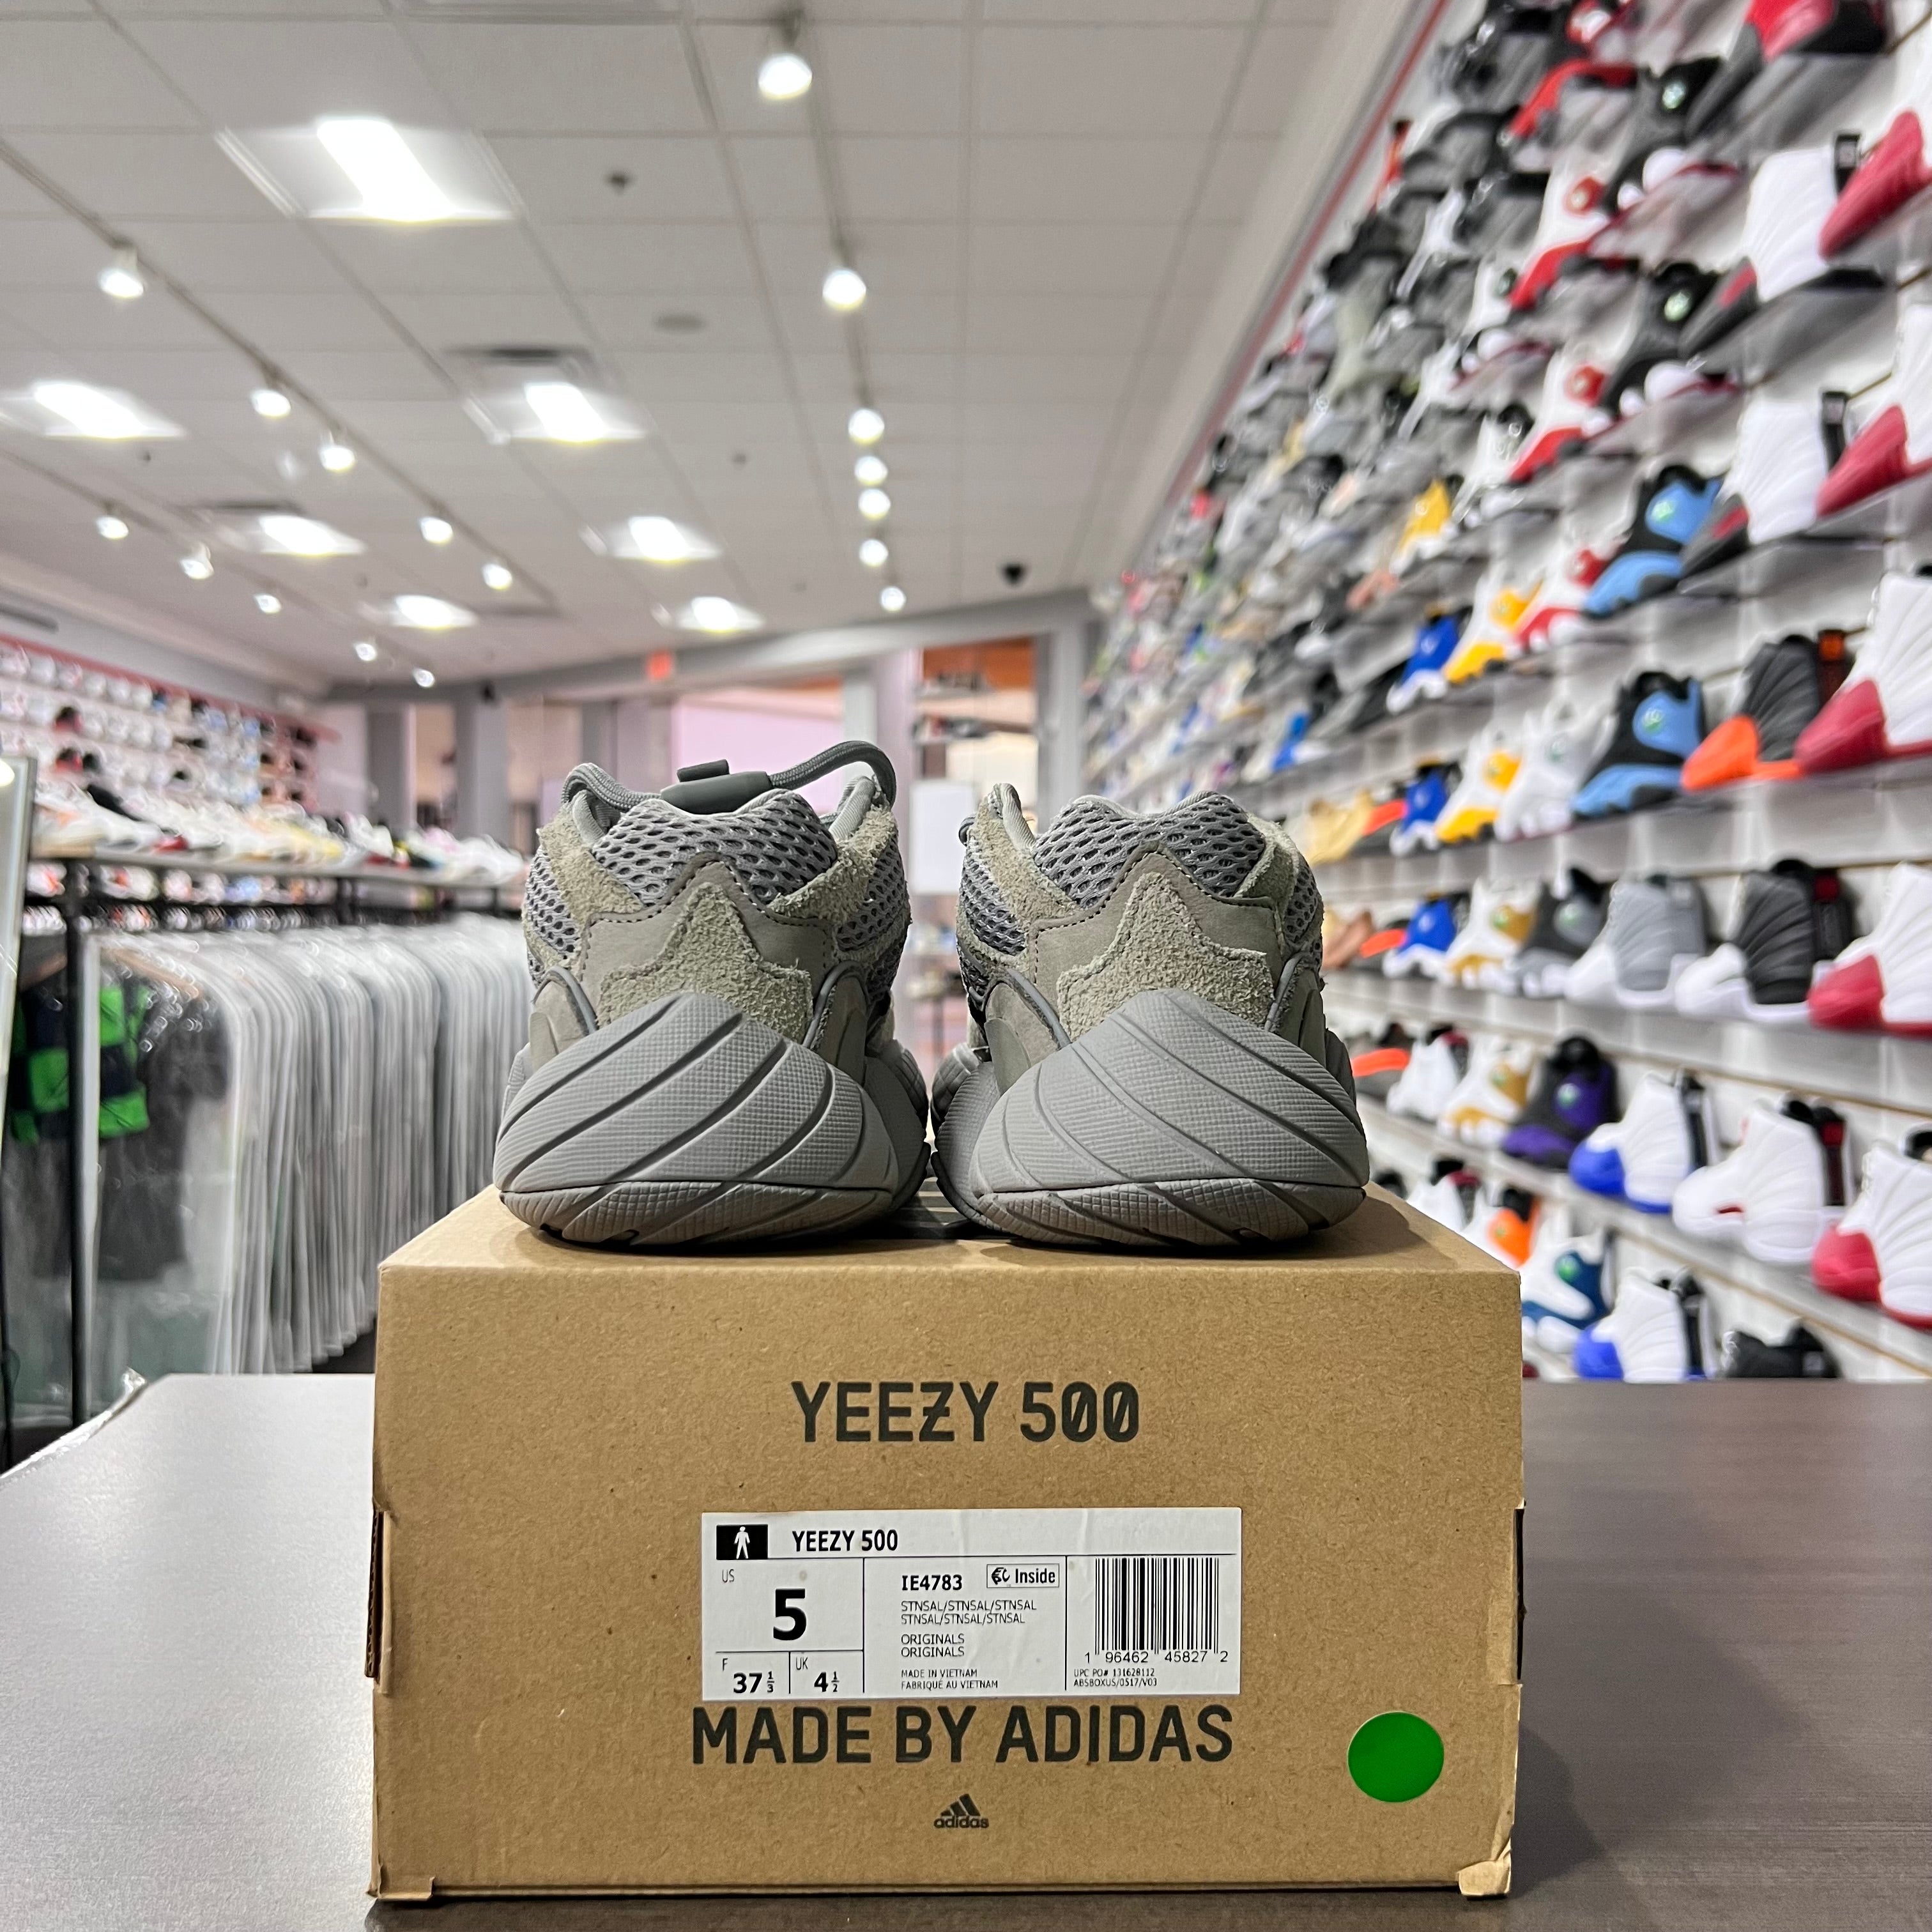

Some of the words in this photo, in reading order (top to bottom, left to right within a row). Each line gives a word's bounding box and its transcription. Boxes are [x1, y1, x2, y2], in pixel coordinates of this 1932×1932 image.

[791, 1381, 999, 1442] YEEZY
[1020, 1381, 1139, 1442] 500
[792, 1530, 855, 1552] YEEZY
[861, 1529, 898, 1551] 500
[721, 1568, 735, 1583] US
[1015, 1568, 1055, 1584] Inside
[901, 1574, 962, 1591] IE4783
[901, 1600, 1037, 1613] STNSAL/STNSAL/STNSAL
[773, 1588, 807, 1641] 5
[901, 1613, 1025, 1625] STNSAL/STNSAL/STNSAL
[901, 1633, 965, 1644] ORIGINALS
[901, 1646, 965, 1657] ORIGINALS
[1084, 1652, 1090, 1664] 1
[1105, 1652, 1149, 1663] 96462
[1164, 1650, 1208, 1662] 45827
[1220, 1650, 1229, 1662] 2
[722, 1658, 728, 1671] F
[795, 1657, 808, 1671] UK
[901, 1669, 925, 1678] MADE
[928, 1669, 937, 1678] IN
[939, 1669, 977, 1678] VIETNAM
[1073, 1668, 1089, 1677] UPC
[1092, 1668, 1108, 1677] PO#
[1112, 1668, 1155, 1677] 131628112
[946, 1680, 958, 1689] AU
[960, 1680, 998, 1689] VIETNAM
[1073, 1678, 1157, 1688] ABSBOXUS/0517/V03
[693, 1706, 871, 1764] MADE
[896, 1705, 977, 1763] BY
[995, 1705, 1233, 1765] ADIDAS
[933, 1815, 989, 1828] adidas
